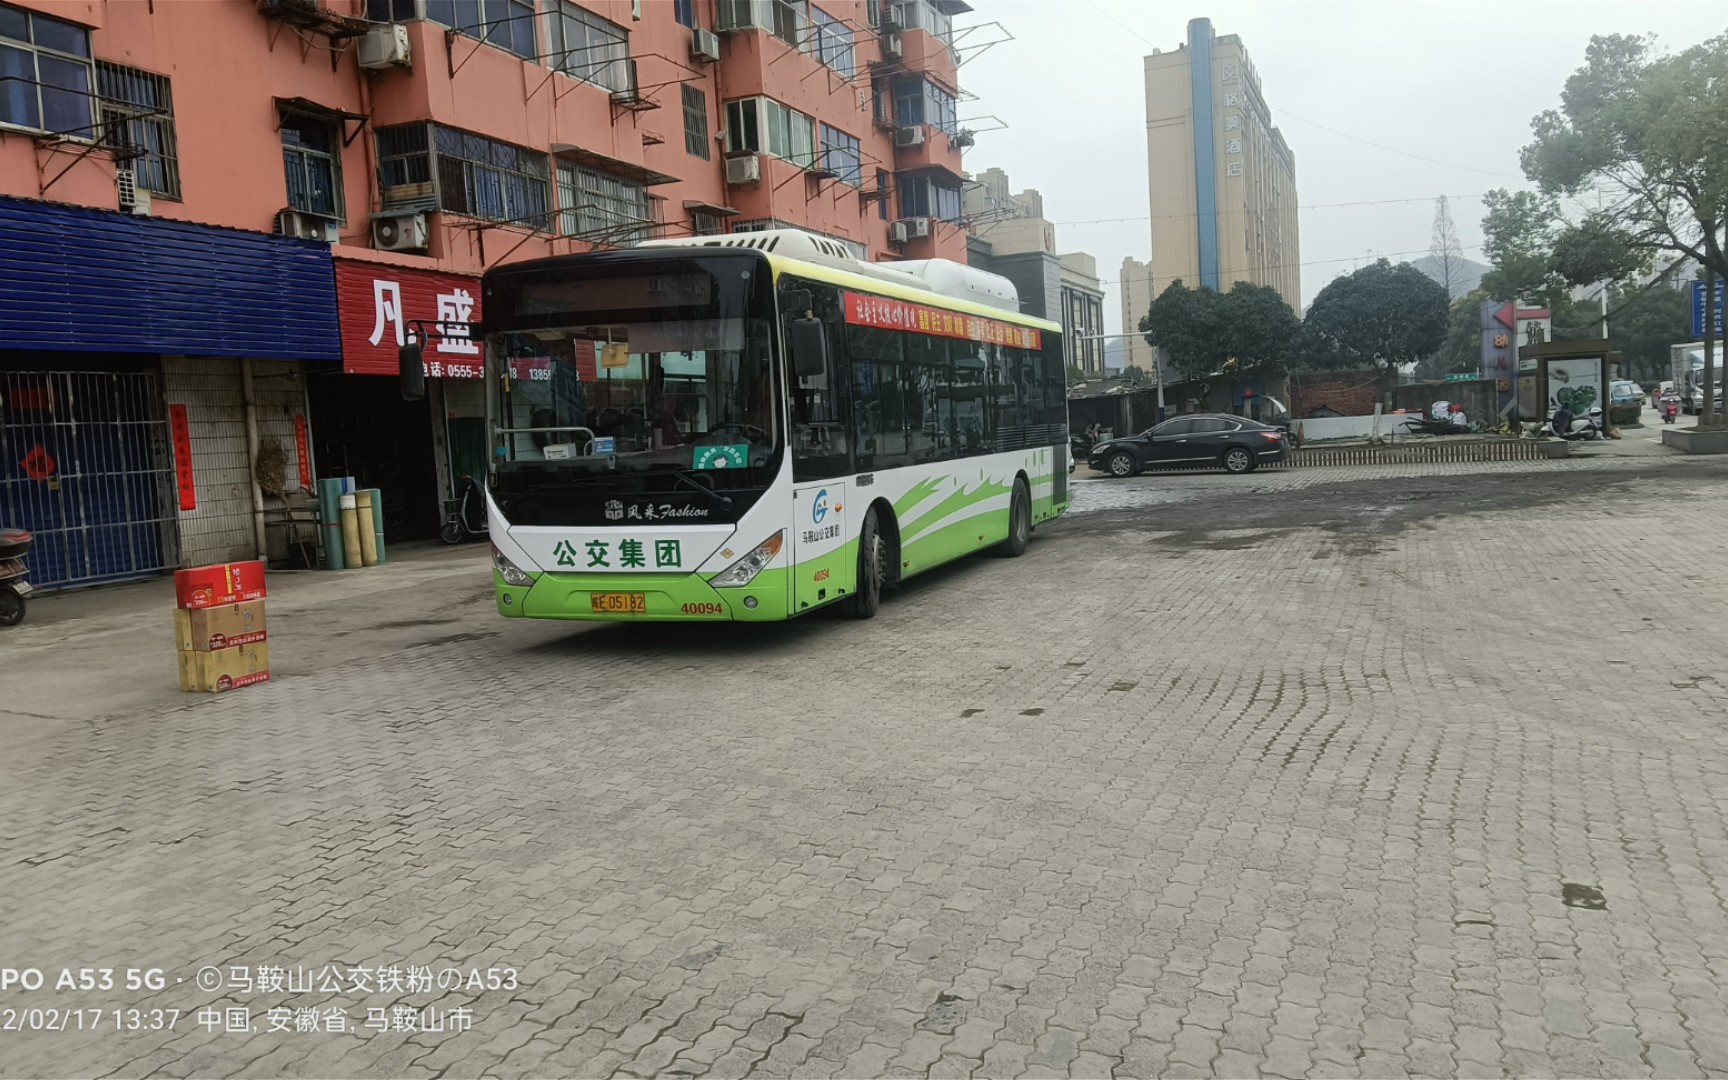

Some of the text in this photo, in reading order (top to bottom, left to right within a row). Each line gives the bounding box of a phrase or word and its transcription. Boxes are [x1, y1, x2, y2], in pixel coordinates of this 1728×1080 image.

[1223, 92, 1242, 177] 格美酒店
[1494, 333, 1509, 391] 幼儿园
[802, 523, 840, 545] 马鞍山公交集团
[552, 538, 682, 568] 公交集团
[813, 568, 830, 582] 40094
[680, 602, 723, 614] 40094
